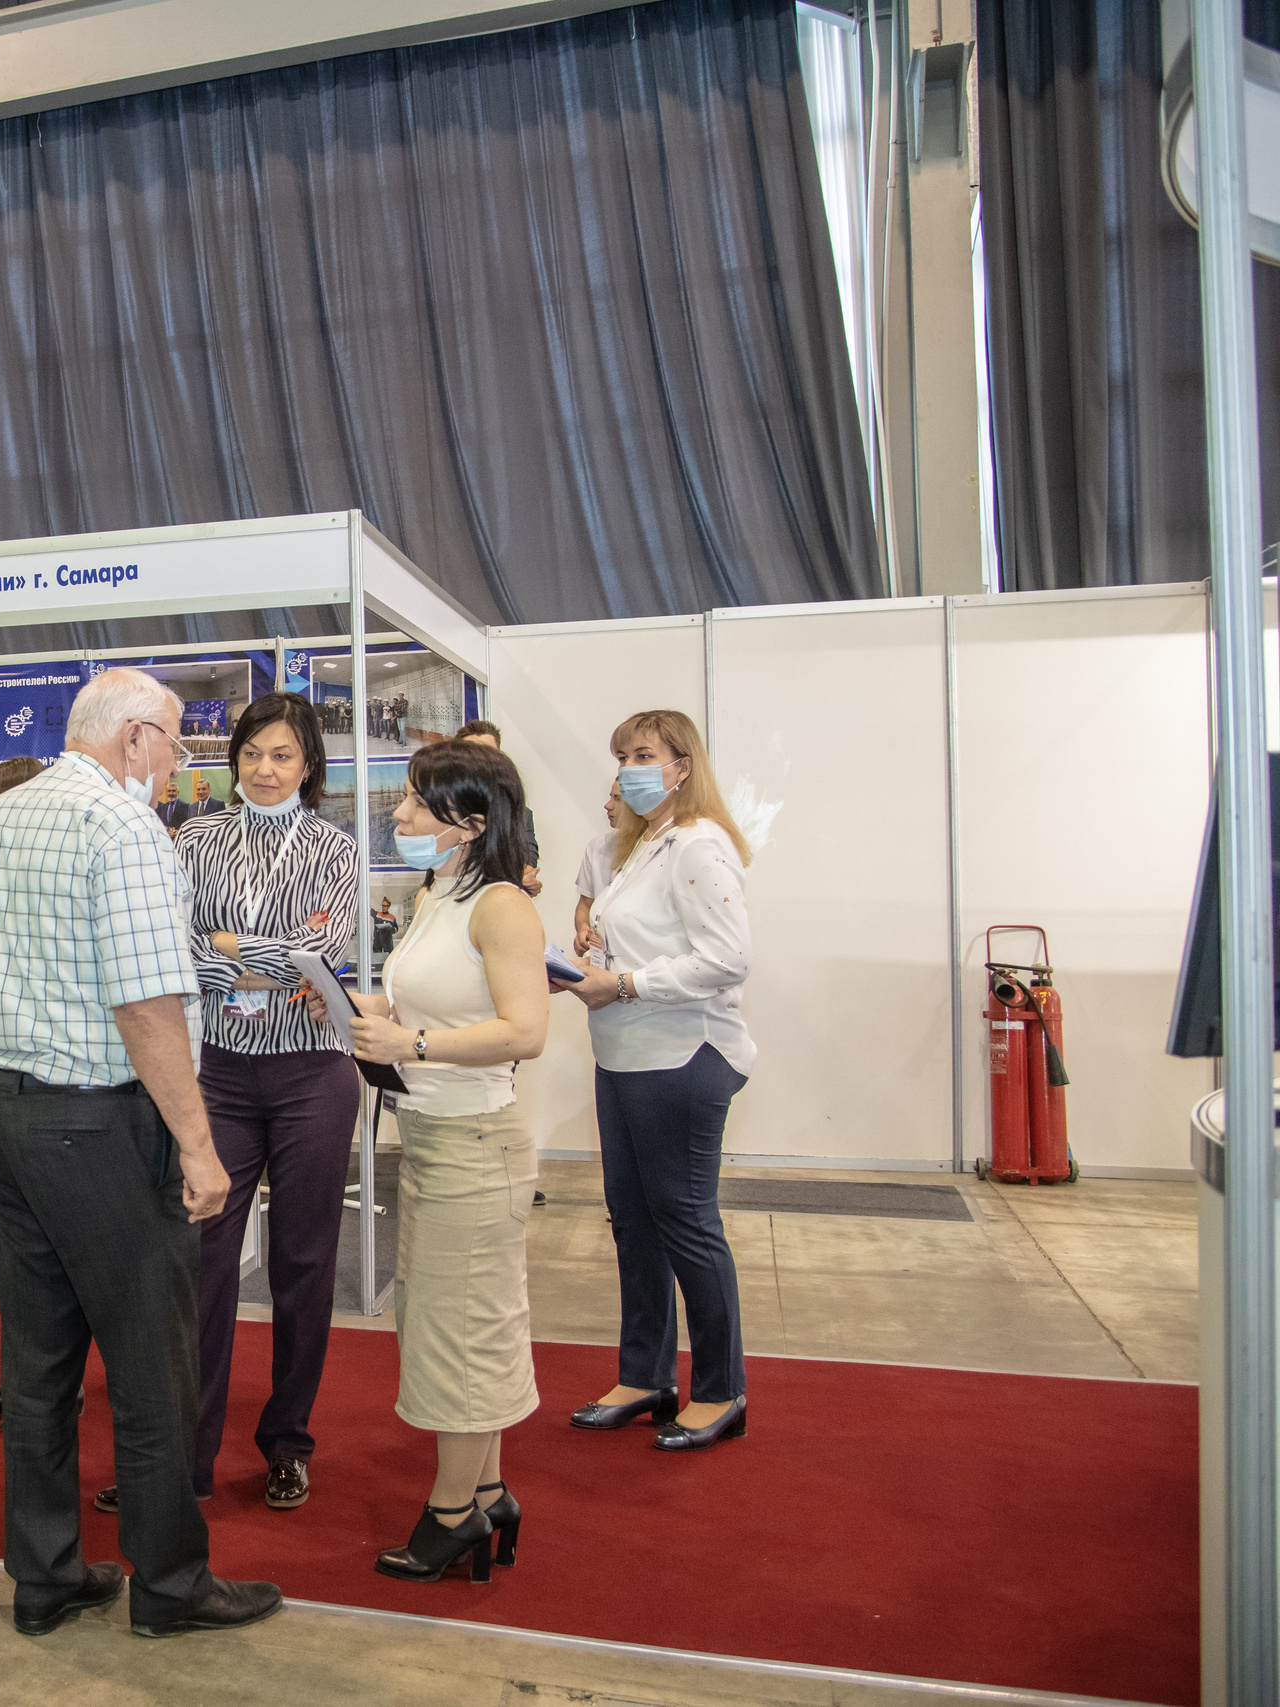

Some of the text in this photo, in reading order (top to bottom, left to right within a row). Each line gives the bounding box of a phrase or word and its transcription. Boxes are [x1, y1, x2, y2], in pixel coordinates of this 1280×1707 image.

[34, 572, 48, 589] г.
[56, 564, 138, 588] Самара
[48, 674, 80, 685] России»
